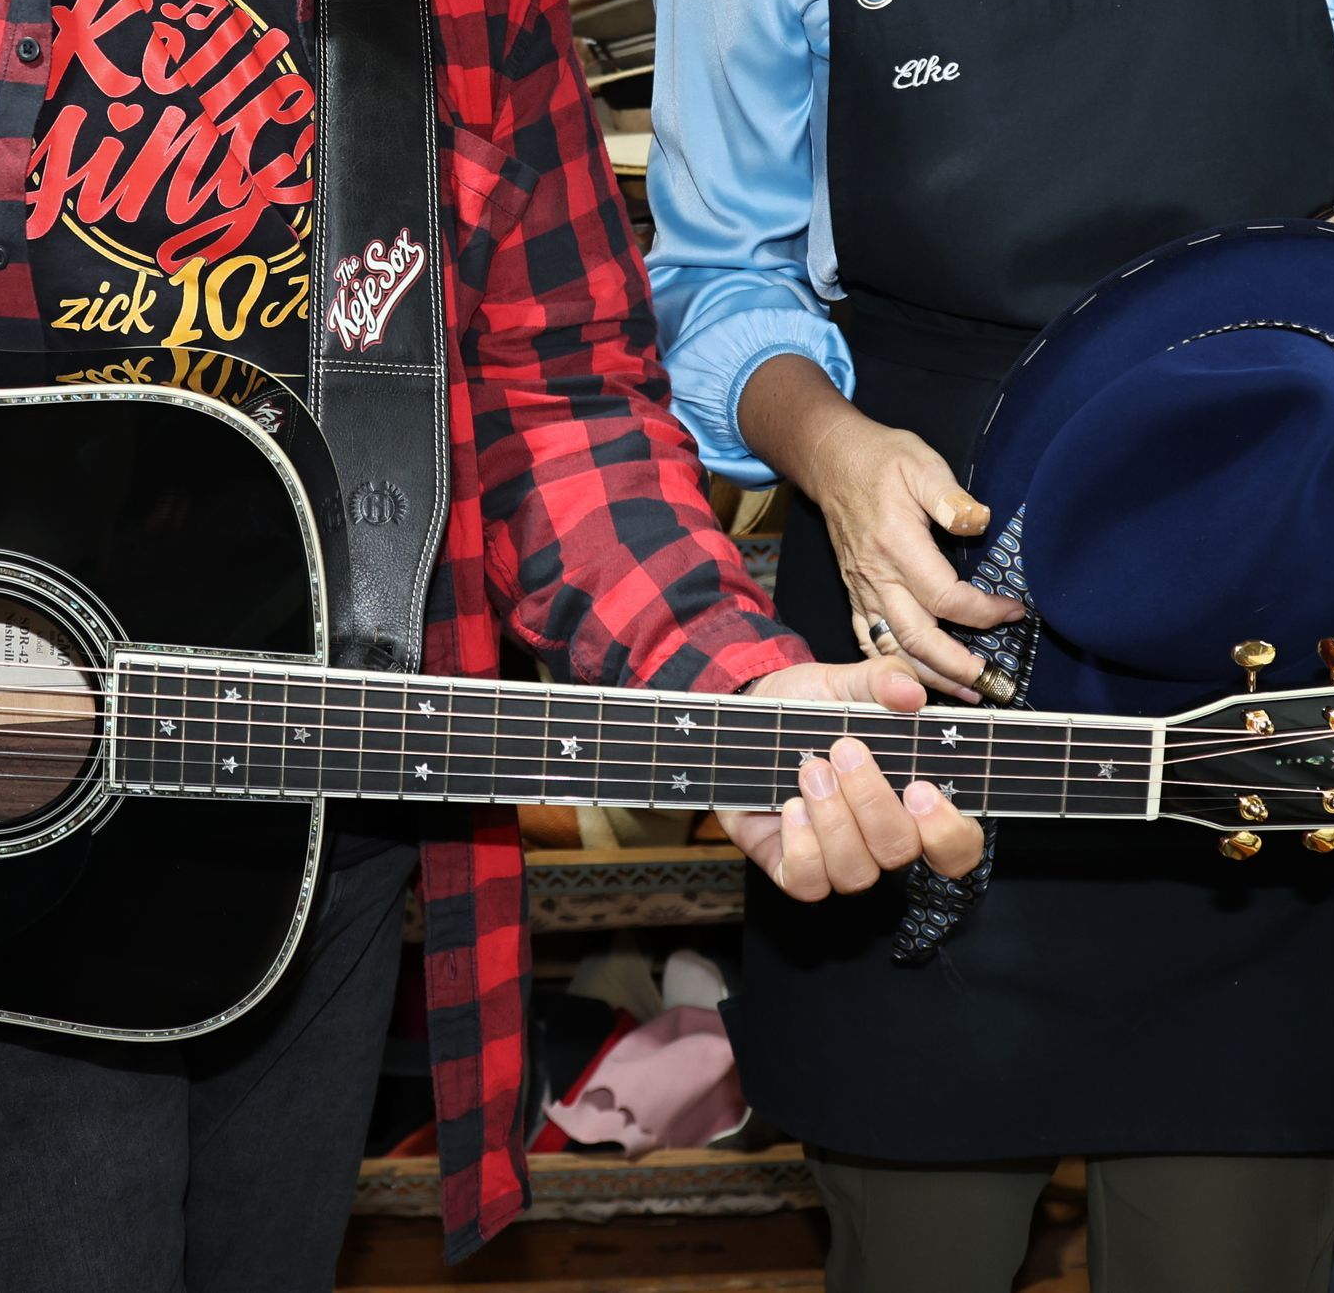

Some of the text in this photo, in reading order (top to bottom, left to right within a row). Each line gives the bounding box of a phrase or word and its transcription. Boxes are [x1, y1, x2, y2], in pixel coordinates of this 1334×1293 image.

[892, 55, 960, 89] Elke
[328, 229, 424, 348] Keje Sox
[333, 256, 361, 287] The
[51, 270, 157, 335] zick
[161, 255, 268, 347] 10
[4, 611, 16, 667] Nashvill
